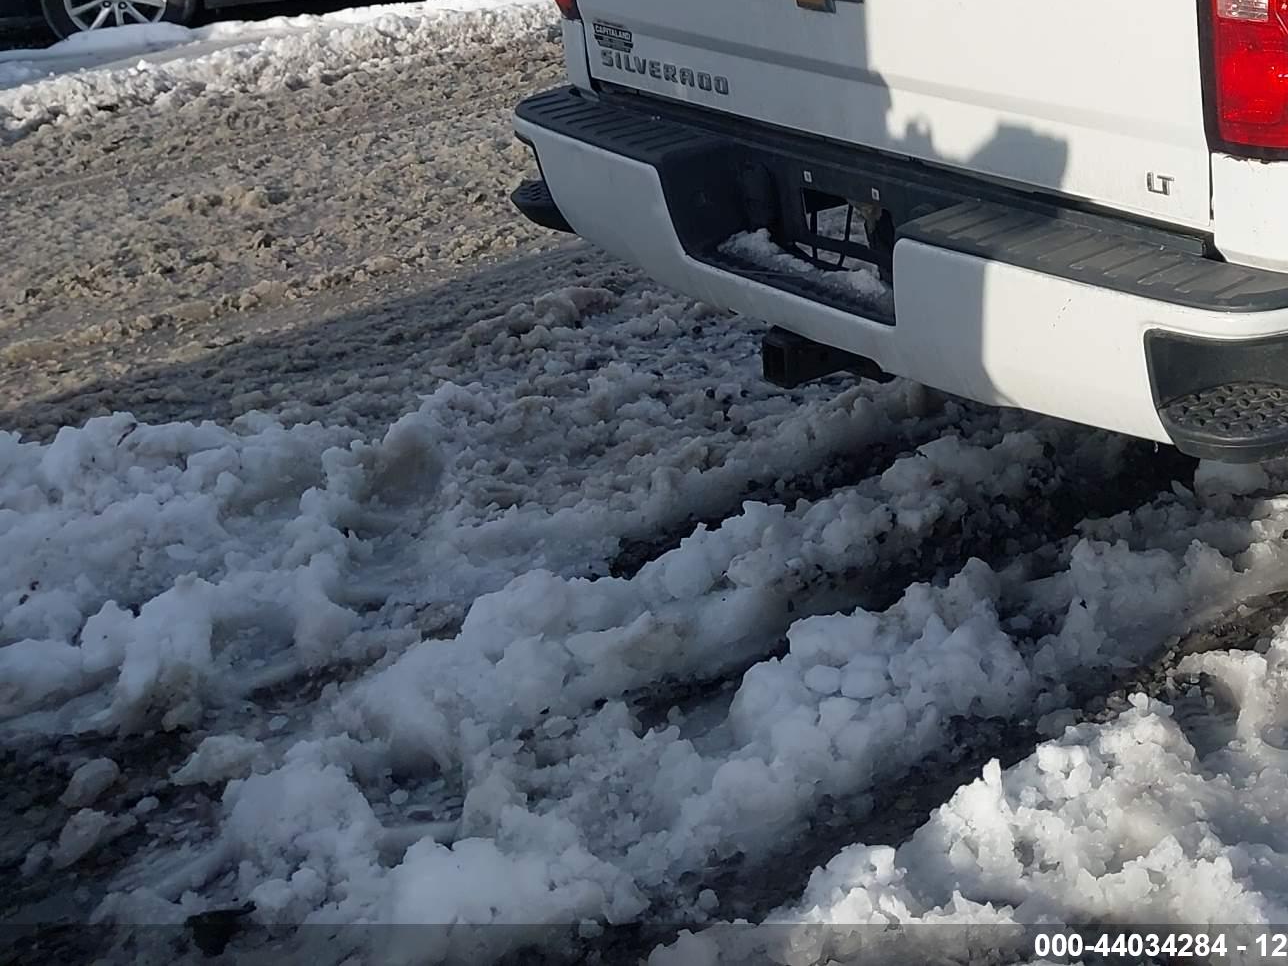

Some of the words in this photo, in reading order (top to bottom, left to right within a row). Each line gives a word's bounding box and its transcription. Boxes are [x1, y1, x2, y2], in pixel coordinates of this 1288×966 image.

[594, 23, 632, 41] CAPITALAND
[600, 48, 729, 96] SILVERADO
[1146, 171, 1175, 196] LT
